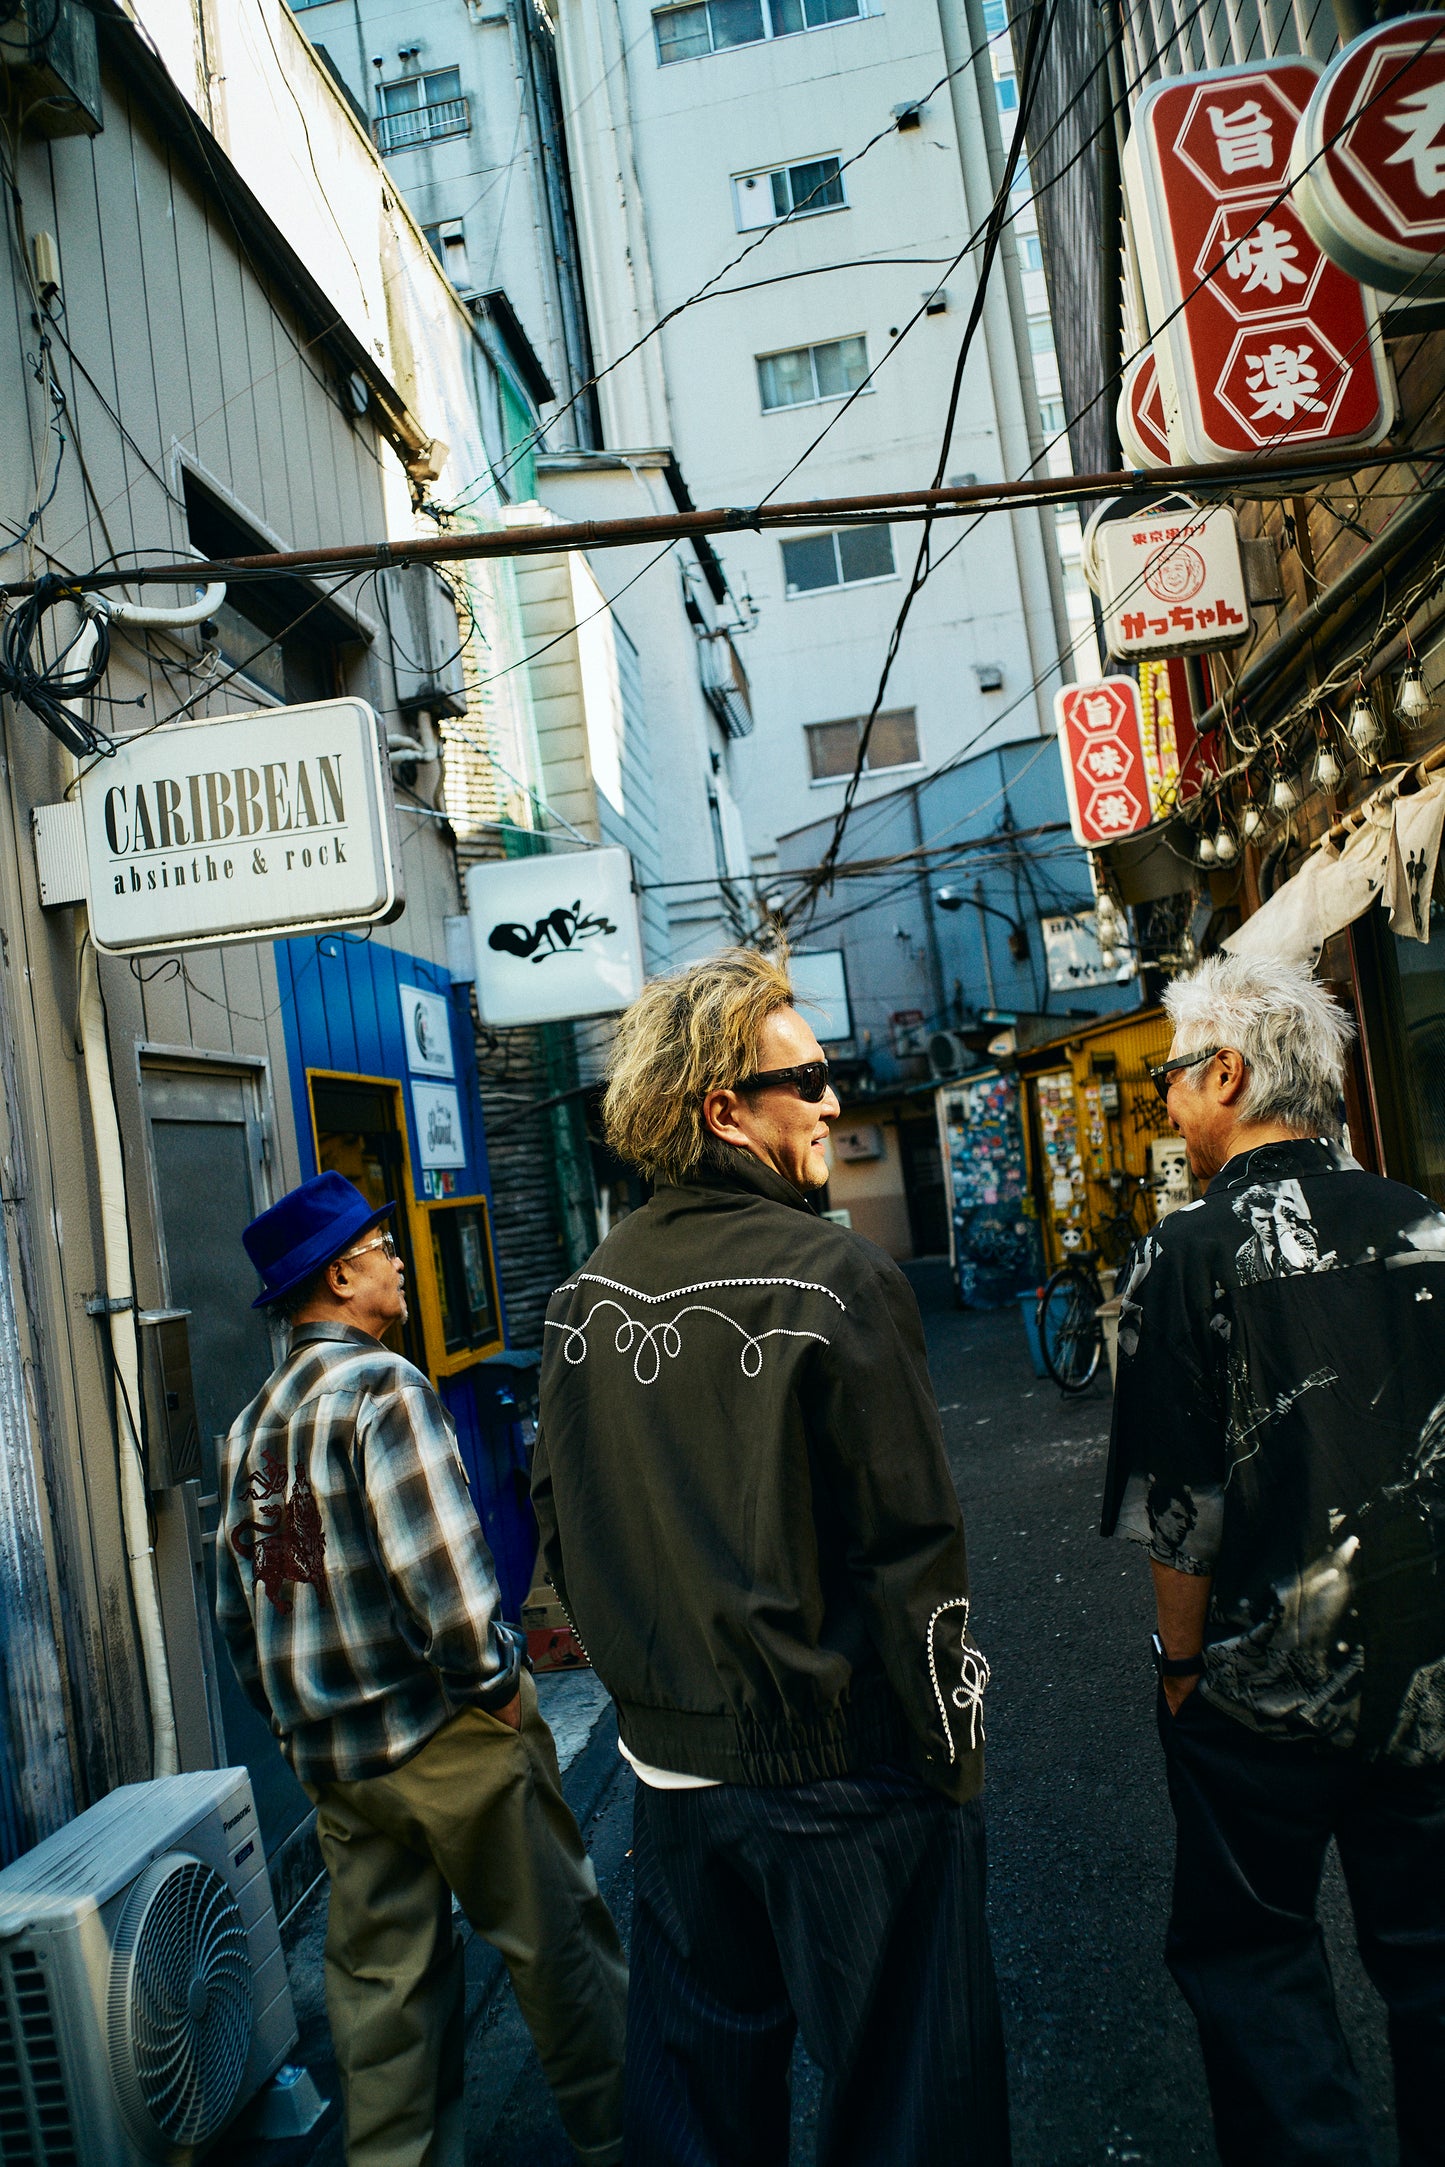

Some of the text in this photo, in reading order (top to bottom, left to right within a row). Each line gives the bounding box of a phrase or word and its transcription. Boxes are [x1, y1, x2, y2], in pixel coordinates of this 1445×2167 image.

[1206, 100, 1329, 420] 旨味楽
[1120, 599, 1244, 640] かっちゃん
[104, 753, 346, 855] CARIBBEAN
[113, 837, 348, 895] absinthe & rock
